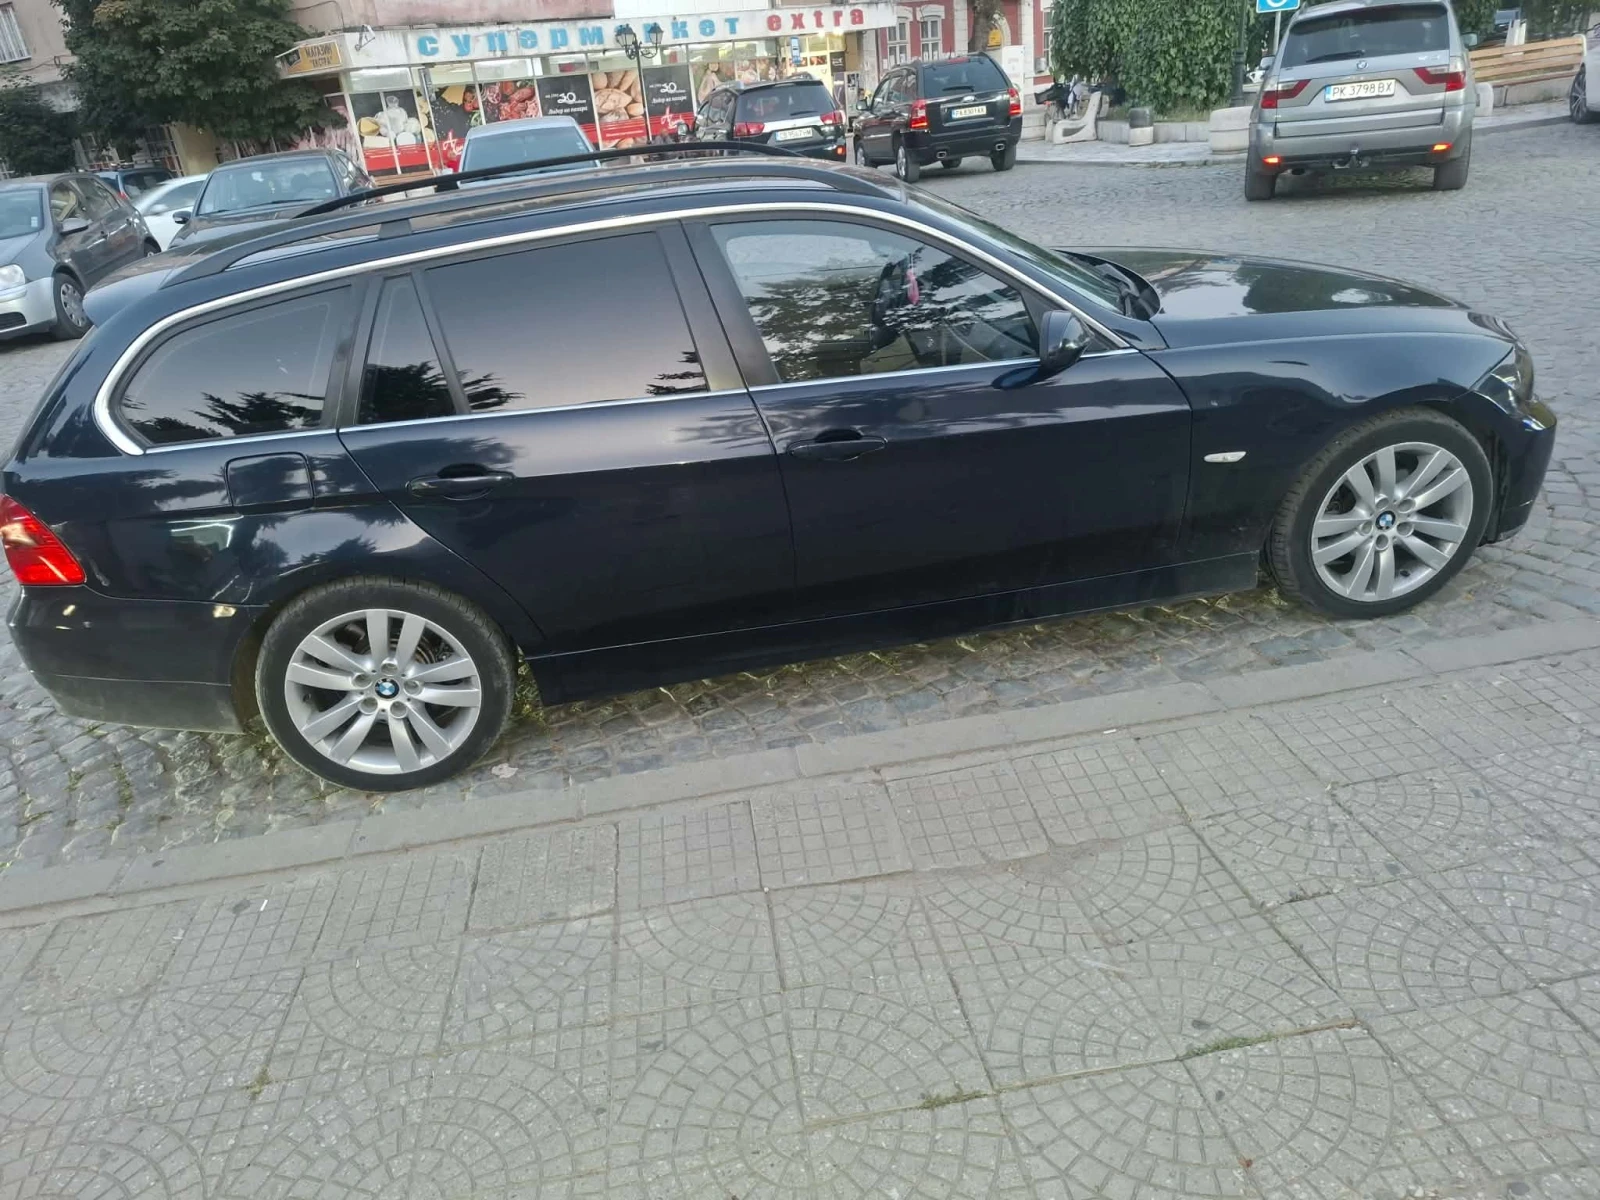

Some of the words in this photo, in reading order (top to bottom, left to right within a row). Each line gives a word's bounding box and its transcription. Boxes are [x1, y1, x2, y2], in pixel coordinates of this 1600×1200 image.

[766, 8, 864, 31] extra
[416, 17, 739, 57] супермркет
[304, 43, 333, 58] МАГАЗИН
[1349, 84, 1376, 96] 3798
